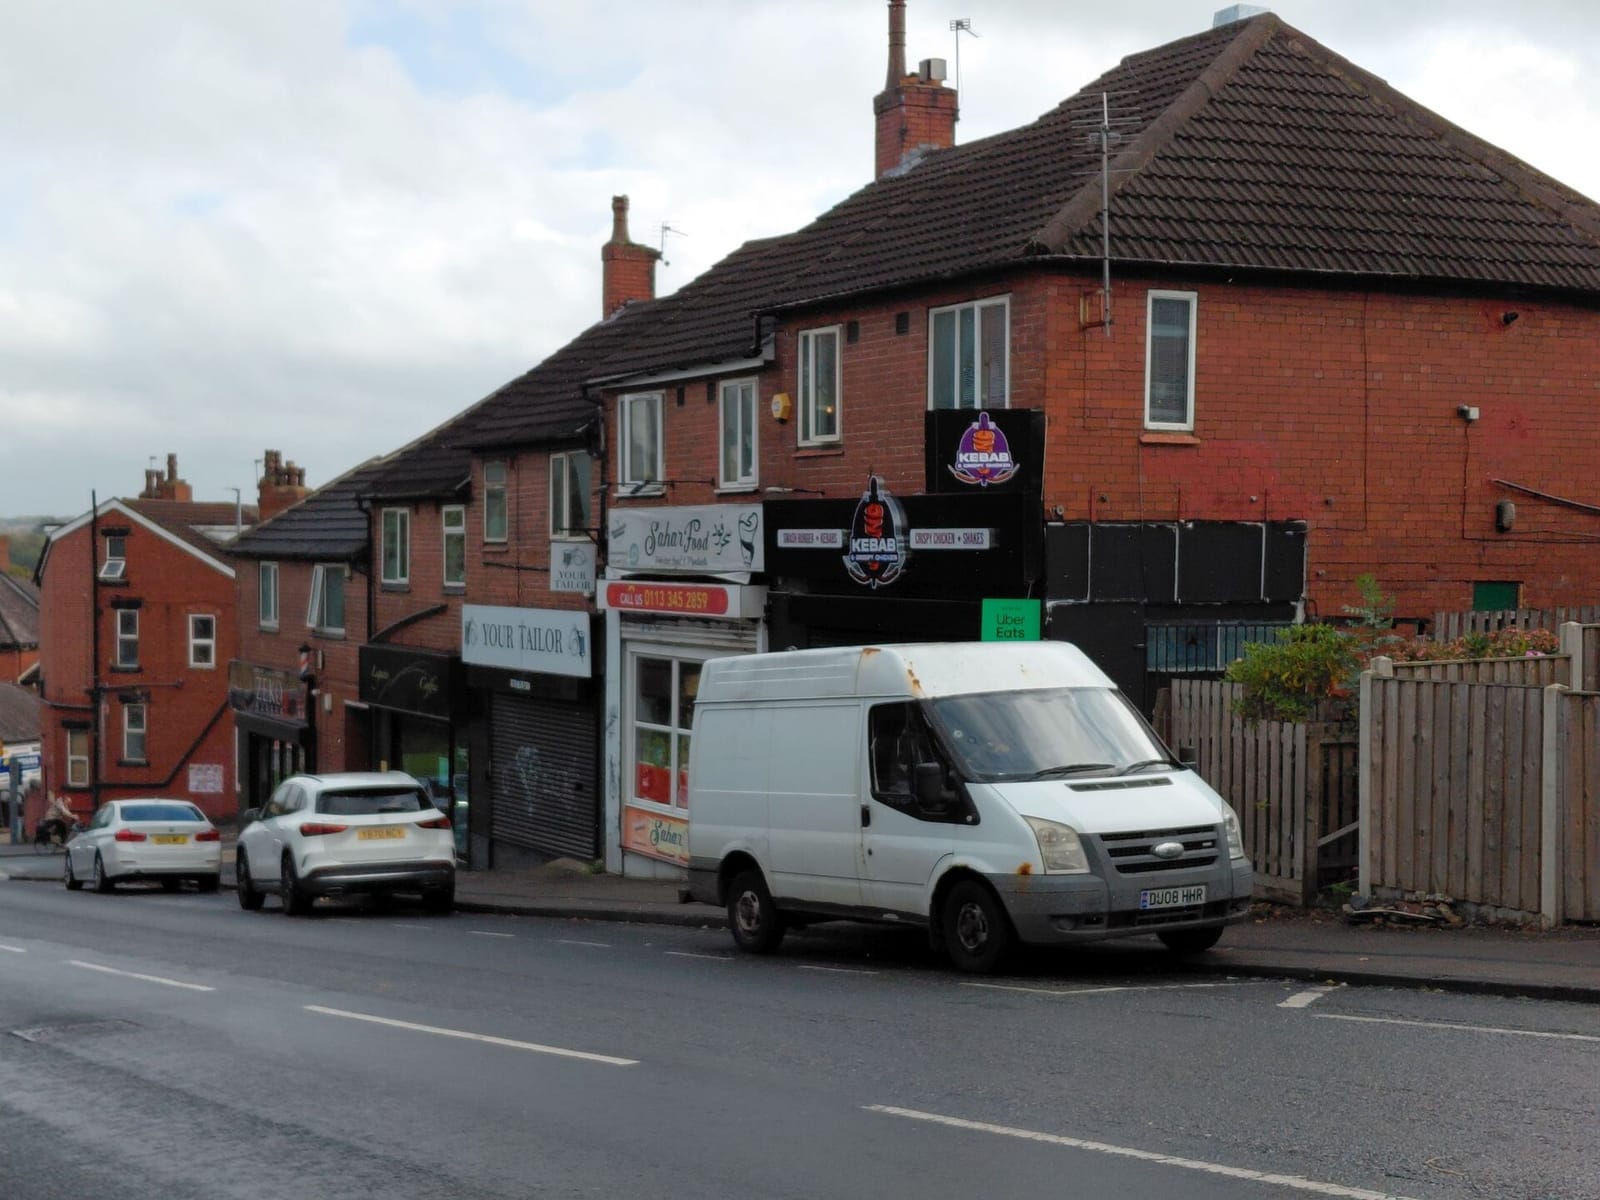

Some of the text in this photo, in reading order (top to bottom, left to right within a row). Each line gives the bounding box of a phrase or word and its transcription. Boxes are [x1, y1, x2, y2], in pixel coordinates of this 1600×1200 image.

[959, 452, 1010, 463] KEBAB
[915, 532, 984, 545] CRISPY CHICKEN SHAKES
[852, 538, 897, 552] KEBAB
[558, 570, 586, 579] YOUR
[555, 581, 591, 590] TAILOR
[620, 589, 709, 609] CALL US 0113 345 2859
[996, 614, 1025, 625] Uber
[482, 623, 564, 653] YOUR TAILOR
[996, 627, 1025, 638] Eats
[1149, 888, 1204, 906] DU08 HHR
